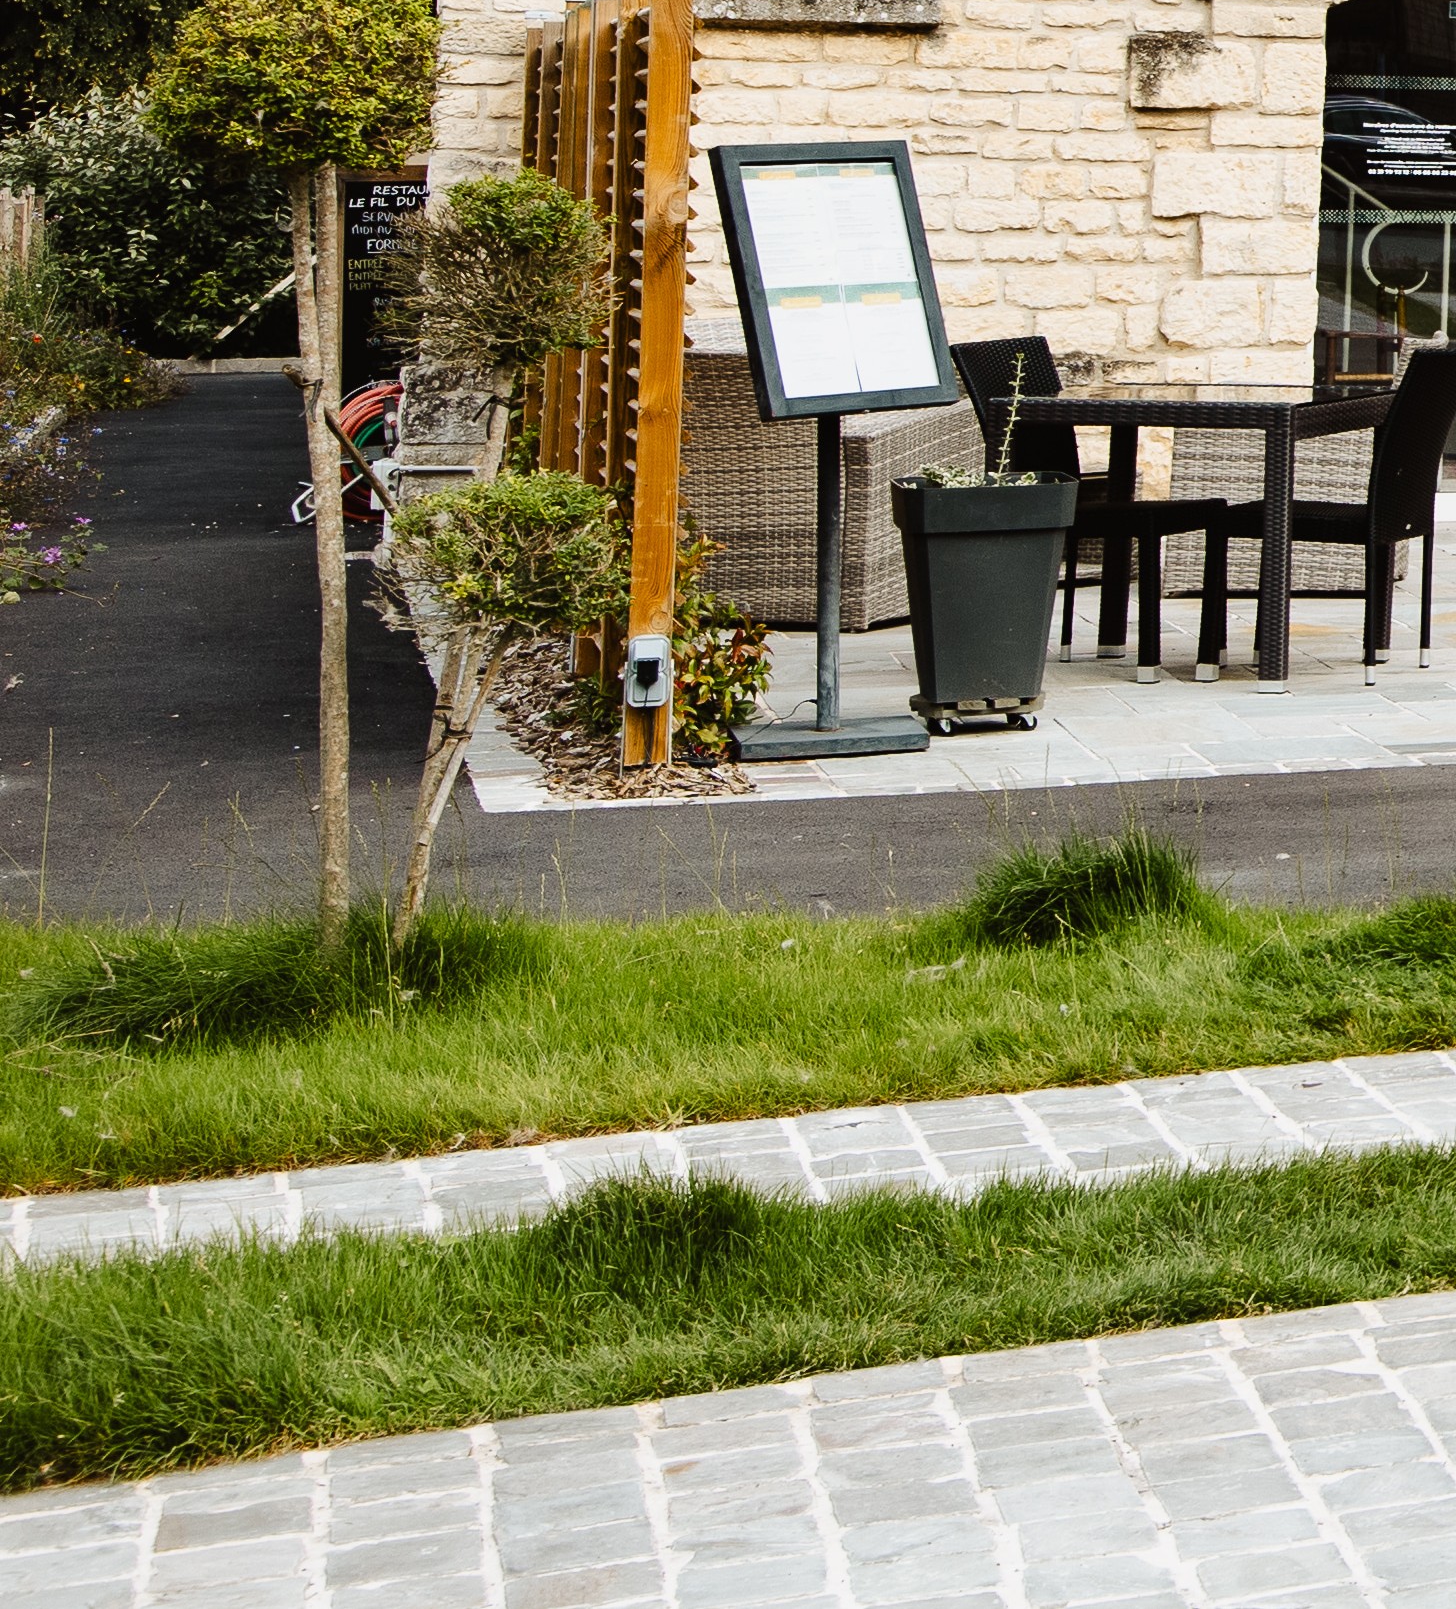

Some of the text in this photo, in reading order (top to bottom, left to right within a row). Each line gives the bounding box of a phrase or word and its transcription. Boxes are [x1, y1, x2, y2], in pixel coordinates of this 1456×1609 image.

[373, 184, 430, 196] RESTAU
[348, 197, 366, 208] LE
[370, 197, 389, 208] FIL
[396, 196, 416, 208] DU
